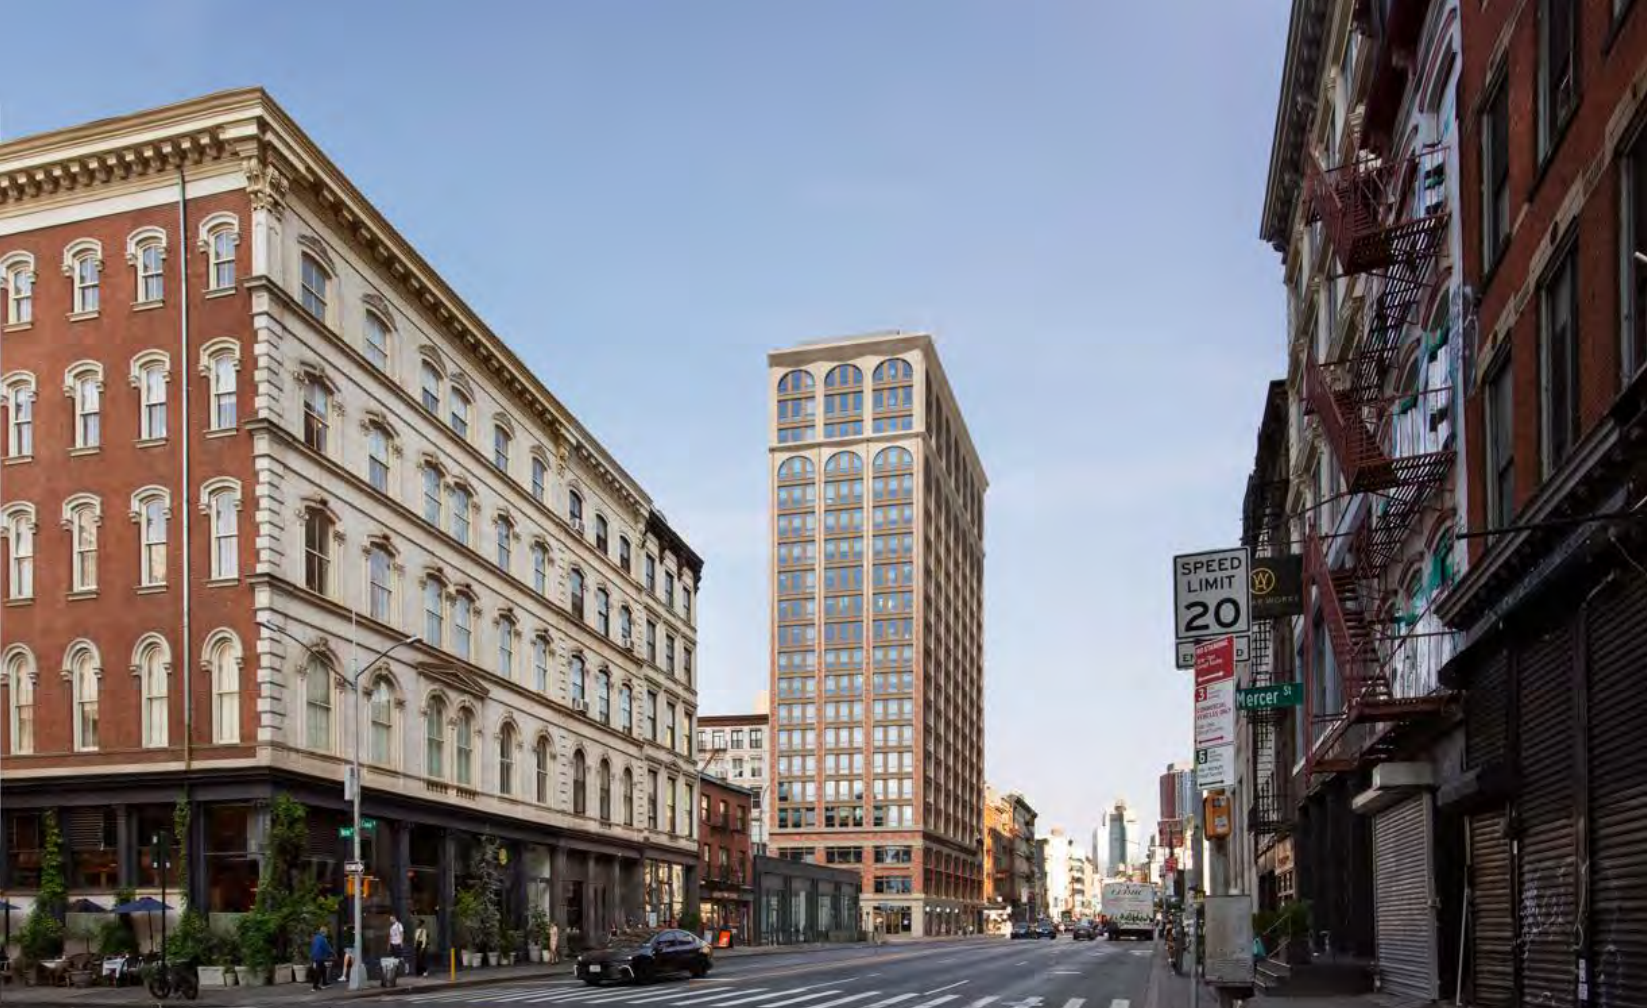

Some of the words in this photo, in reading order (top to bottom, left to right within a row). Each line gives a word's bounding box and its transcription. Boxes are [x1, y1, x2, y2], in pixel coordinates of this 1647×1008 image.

[1181, 557, 1242, 576] SPEED
[1187, 575, 1236, 593] LIMIT
[1184, 597, 1241, 632] 20
[1198, 688, 1205, 701] 3
[1236, 691, 1279, 708] Mercer
[1283, 685, 1292, 696] St
